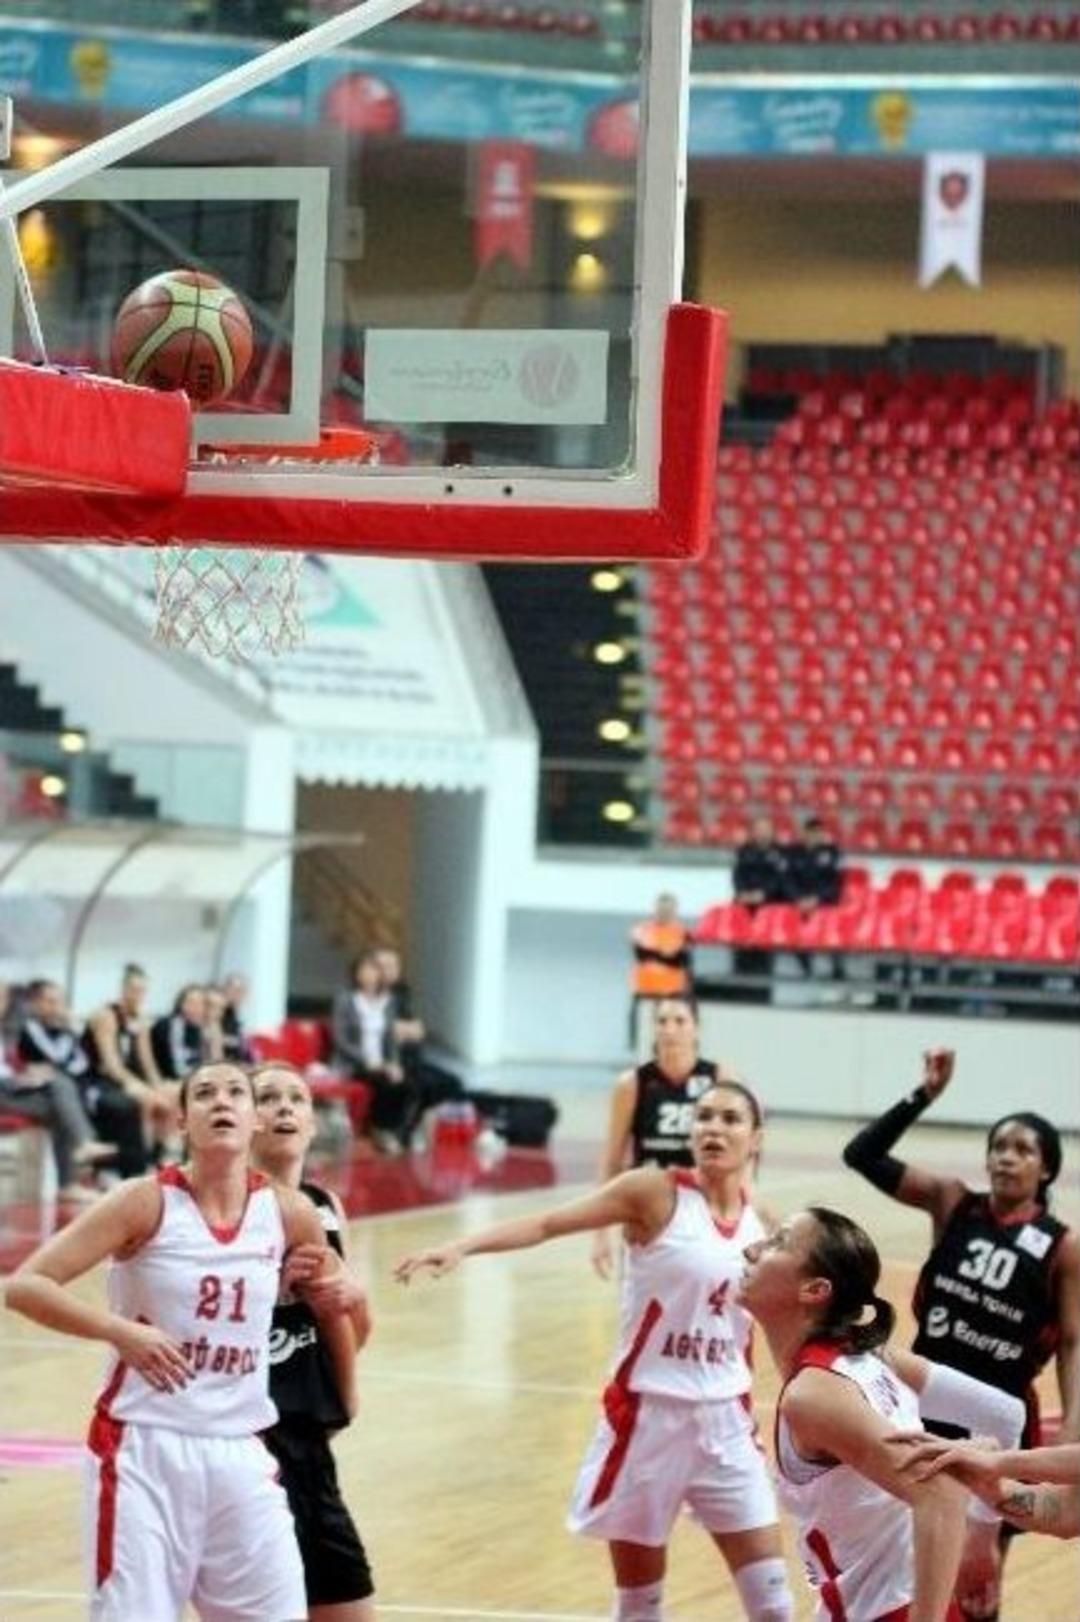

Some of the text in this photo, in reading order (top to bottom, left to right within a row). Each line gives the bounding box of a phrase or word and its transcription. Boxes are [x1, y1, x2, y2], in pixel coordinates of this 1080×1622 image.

[957, 1237, 1019, 1291] 30
[196, 1275, 247, 1322] 21
[708, 1278, 730, 1317] 4
